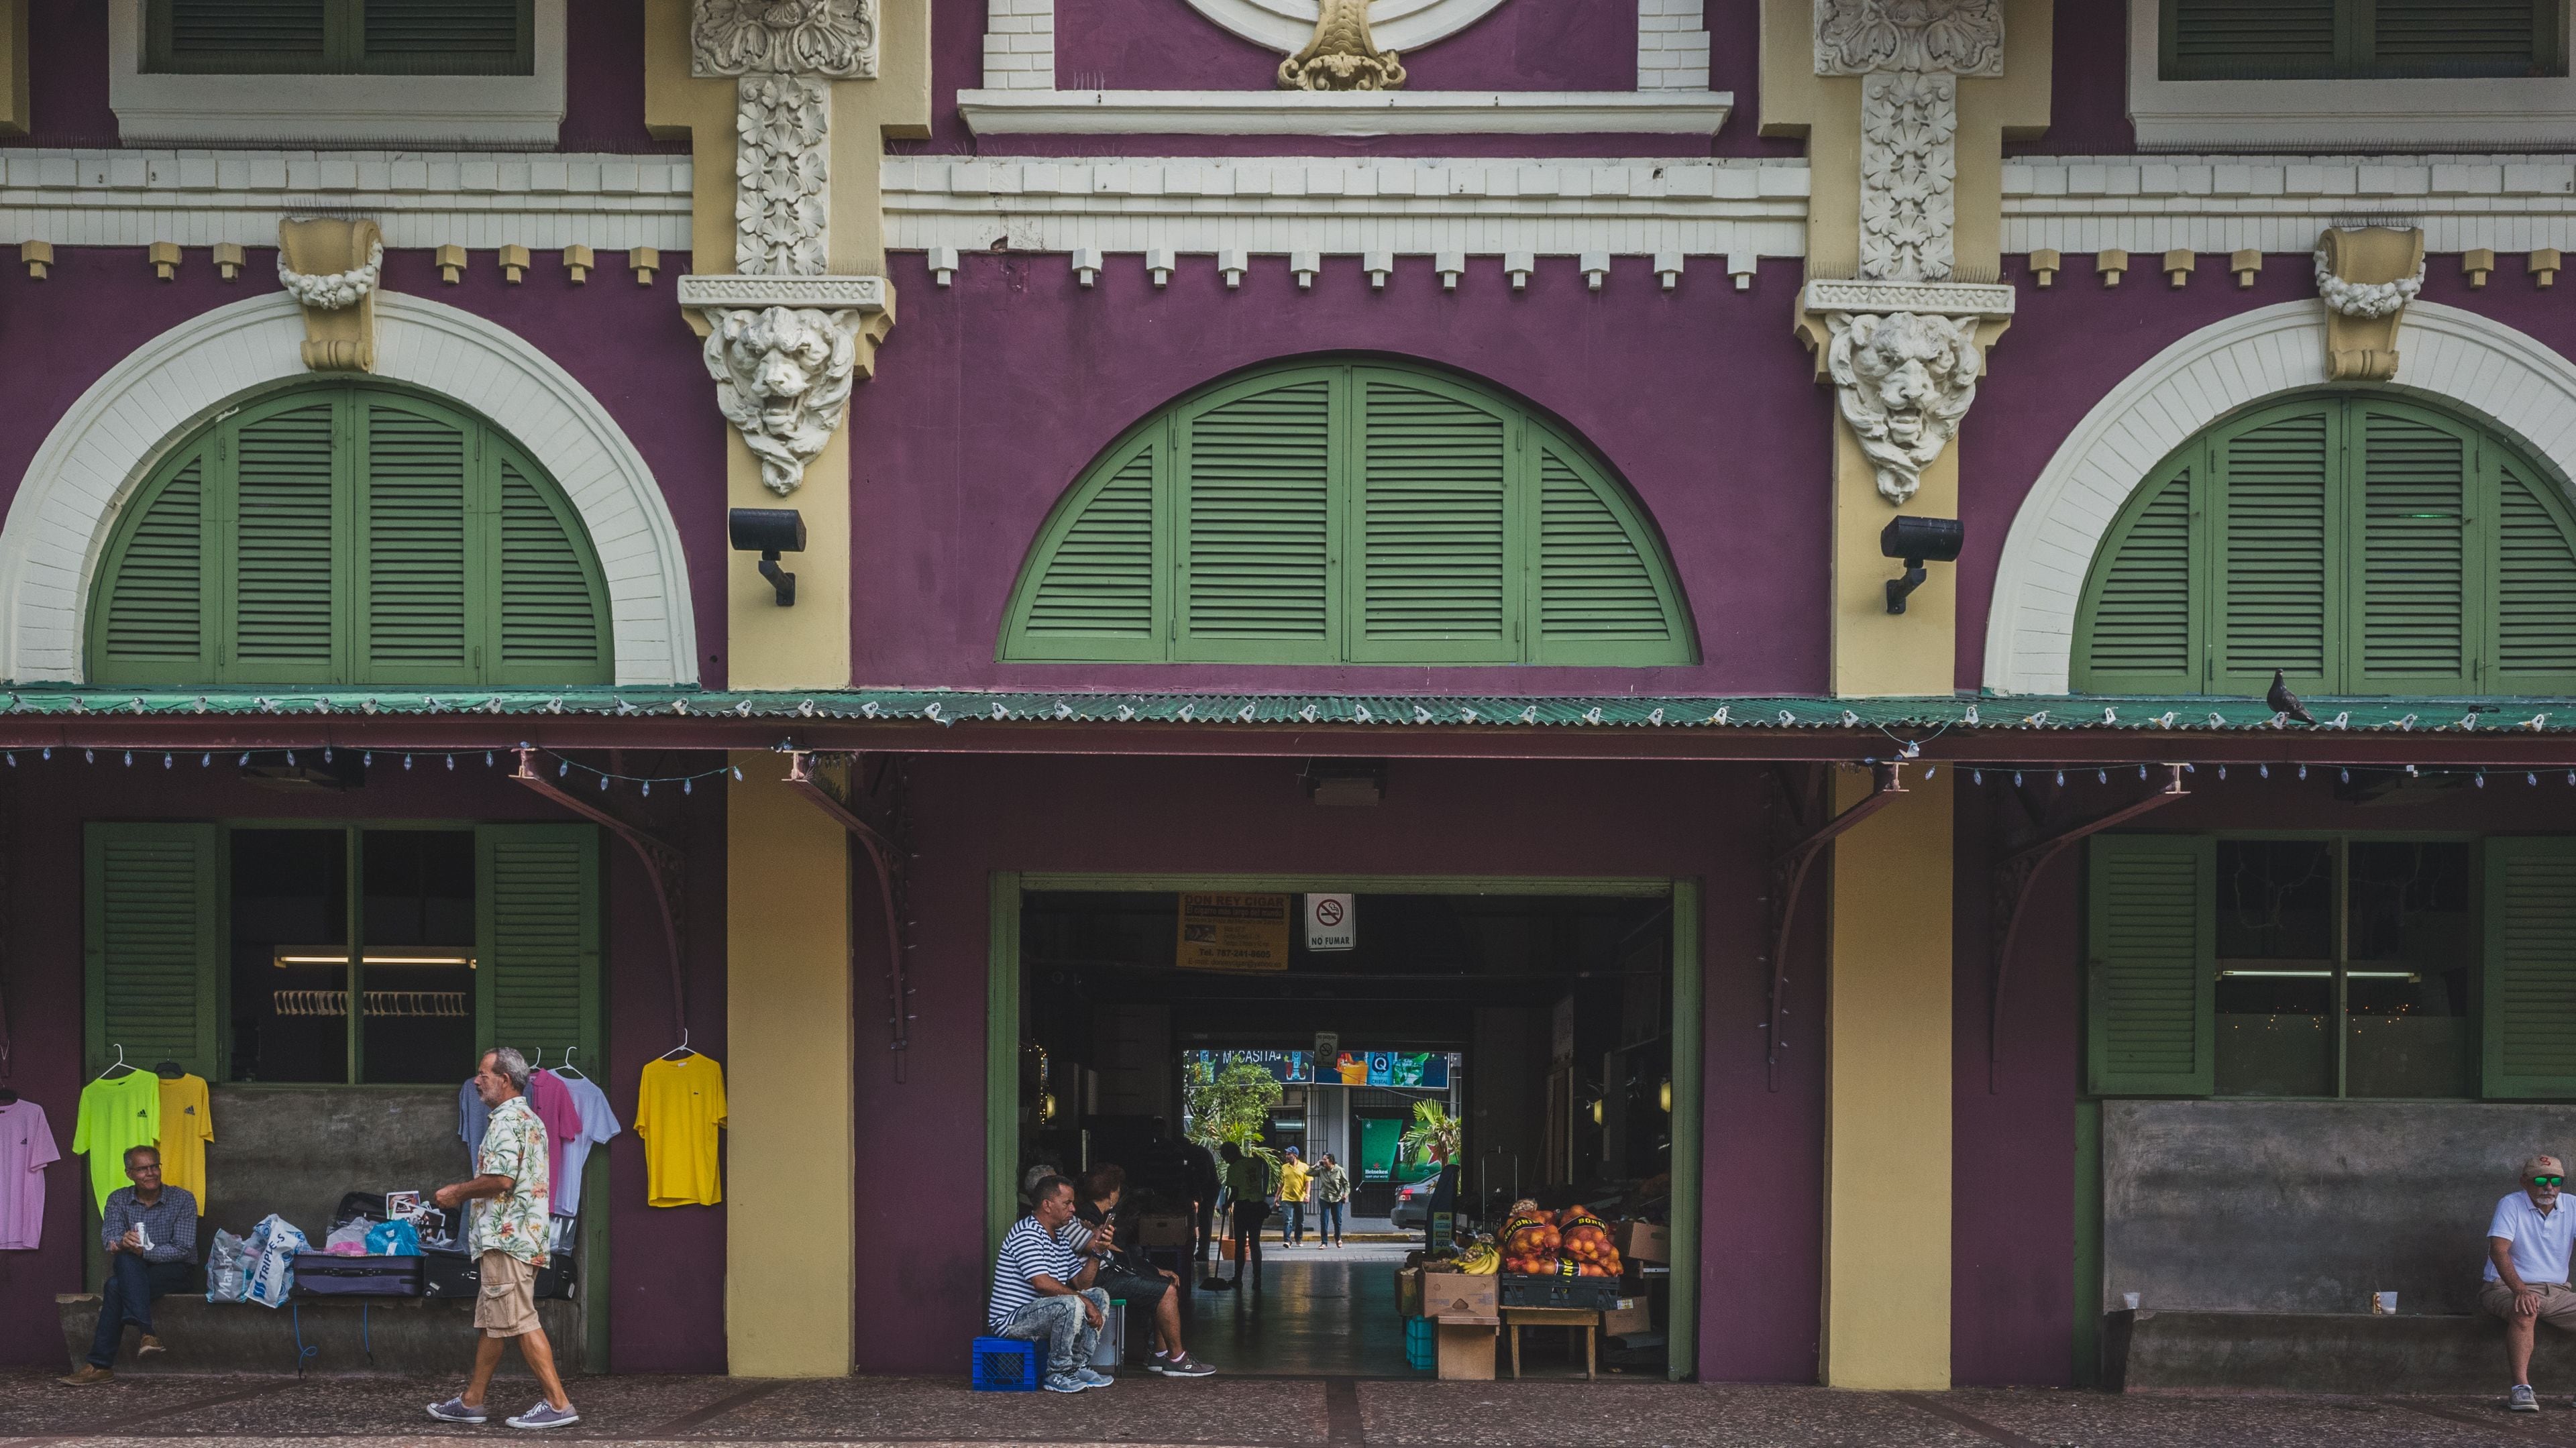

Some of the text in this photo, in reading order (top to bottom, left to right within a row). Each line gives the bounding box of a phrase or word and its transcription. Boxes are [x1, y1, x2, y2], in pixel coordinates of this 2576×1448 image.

[1185, 895, 1284, 907] DON REY CIGAR
[1311, 937, 1350, 945] NO FUMAR
[1199, 948, 1214, 956] Tel.
[1375, 1057, 1387, 1070] Q
